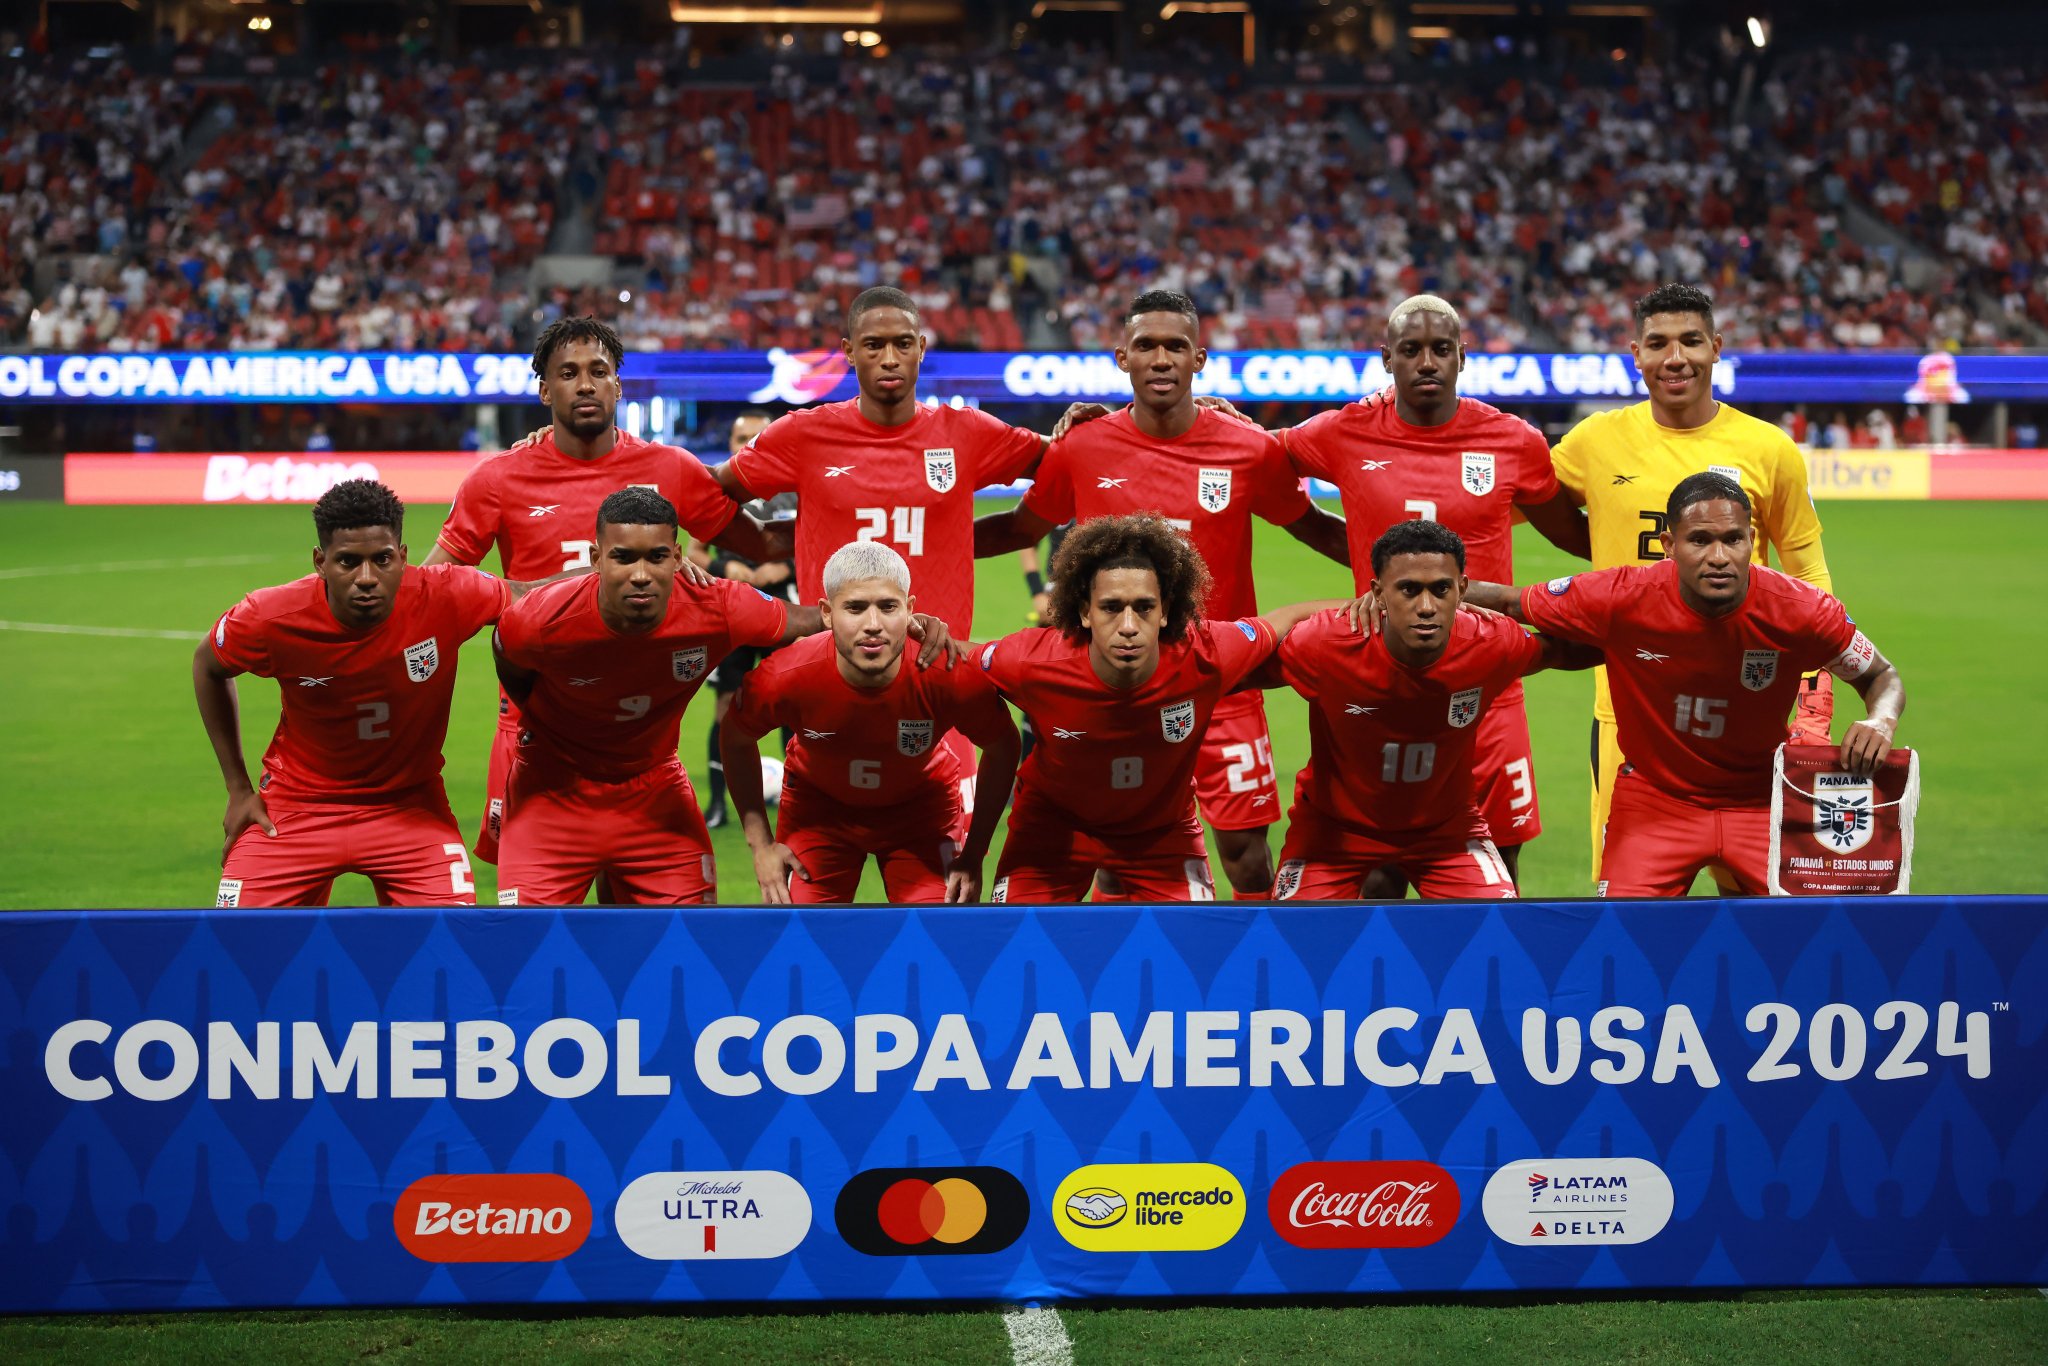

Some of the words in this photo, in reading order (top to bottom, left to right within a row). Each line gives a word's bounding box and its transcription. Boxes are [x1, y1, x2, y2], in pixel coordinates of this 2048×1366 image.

[58, 356, 179, 396] COPA
[181, 356, 378, 396] AMERICA
[384, 355, 470, 396] USA
[1242, 355, 1360, 396] COPA
[1551, 355, 1633, 396] USA
[357, 702, 390, 740] 2
[615, 695, 652, 721] 9
[1674, 694, 1729, 739] 15
[849, 759, 881, 789] 6
[1111, 756, 1143, 789] 8
[1381, 742, 1436, 783] 10
[1505, 757, 1532, 811] 3
[443, 842, 475, 894] 2
[1790, 857, 1824, 869] PANAMÁ
[1833, 860, 1867, 870] ESTADOS
[1869, 861, 1894, 870] UNIDOS
[45, 1018, 671, 1101] CONMEBOL
[694, 1013, 992, 1097] COPA
[1006, 1007, 1496, 1090] AMERICA
[1521, 1003, 1720, 1088] USA
[1744, 1001, 1990, 1082] 2024
[677, 1181, 743, 1197] Michelob
[1136, 1187, 1233, 1206] mercado
[1553, 1176, 1628, 1189] LATAM
[1553, 1194, 1628, 1203] AIRLINES
[415, 1202, 572, 1236] Betano
[664, 1199, 760, 1220] ULTRA
[1136, 1208, 1184, 1226] libre
[1289, 1181, 1440, 1228] Coca-Cola
[1554, 1222, 1625, 1235] DELTA
